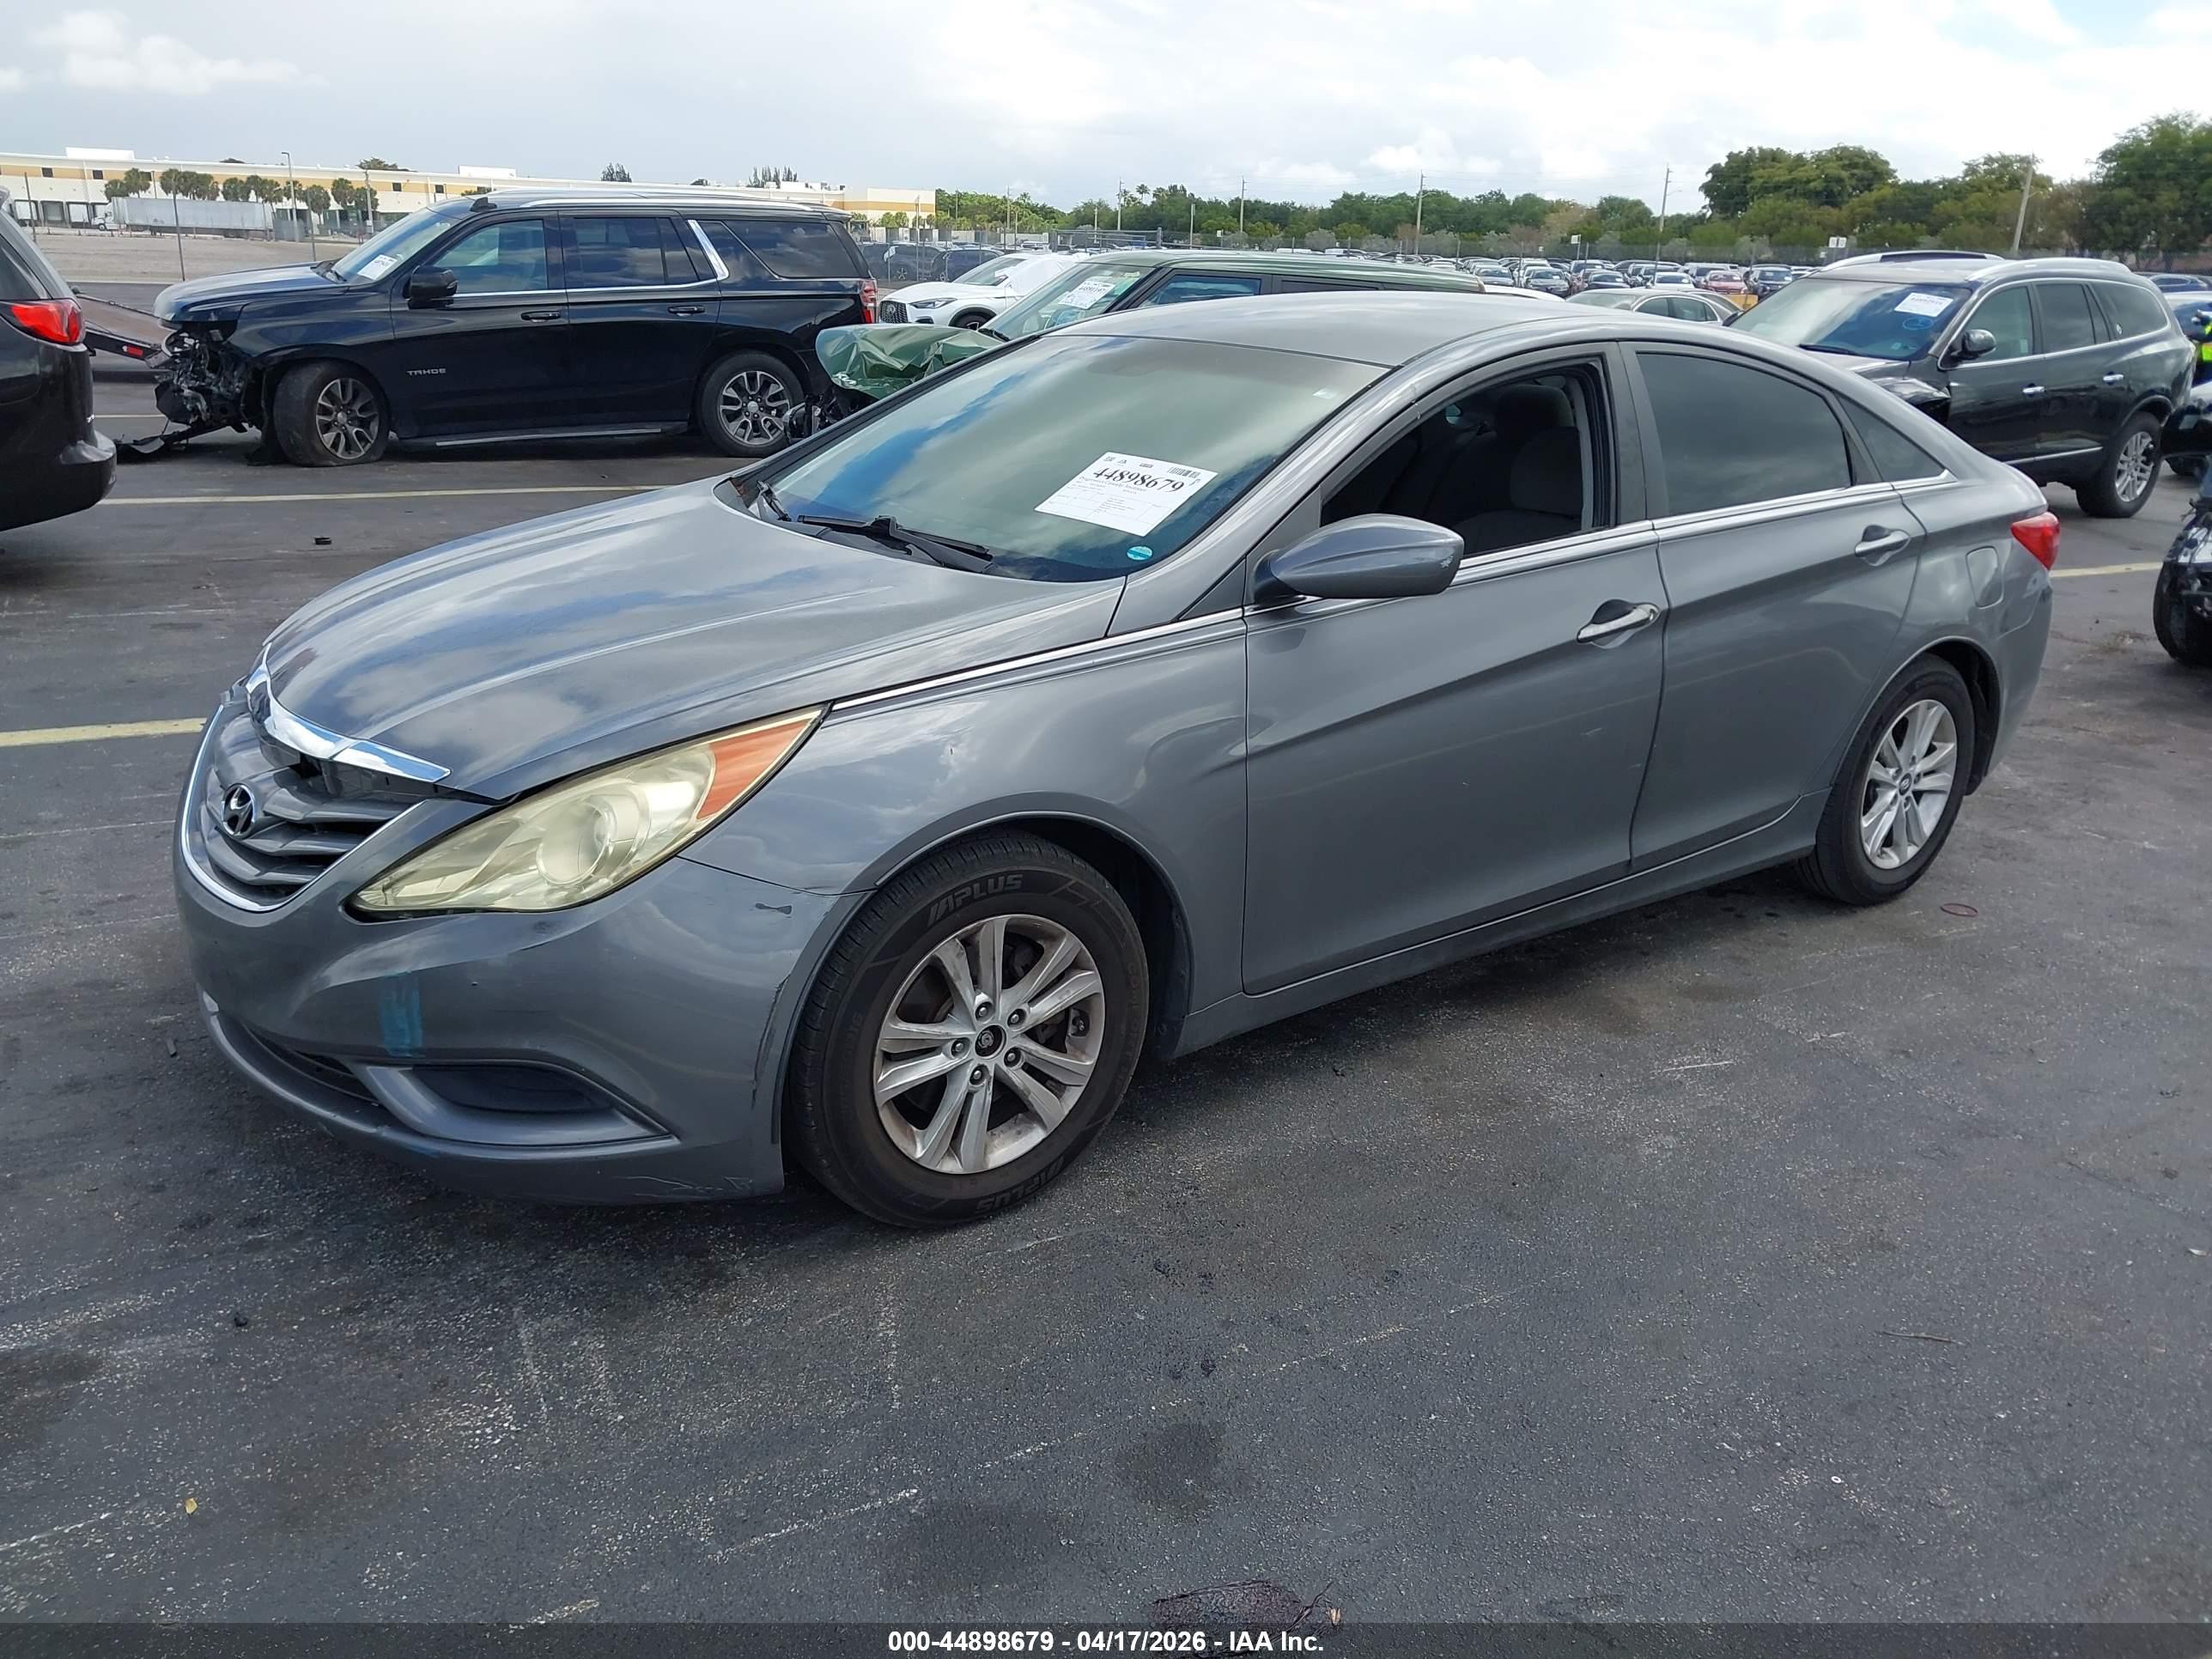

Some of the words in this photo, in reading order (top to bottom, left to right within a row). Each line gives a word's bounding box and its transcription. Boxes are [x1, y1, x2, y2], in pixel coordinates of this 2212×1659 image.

[406, 368, 447, 376] TAHOE
[1092, 466, 1185, 493] 44898679
[927, 873, 1024, 927] APLUS
